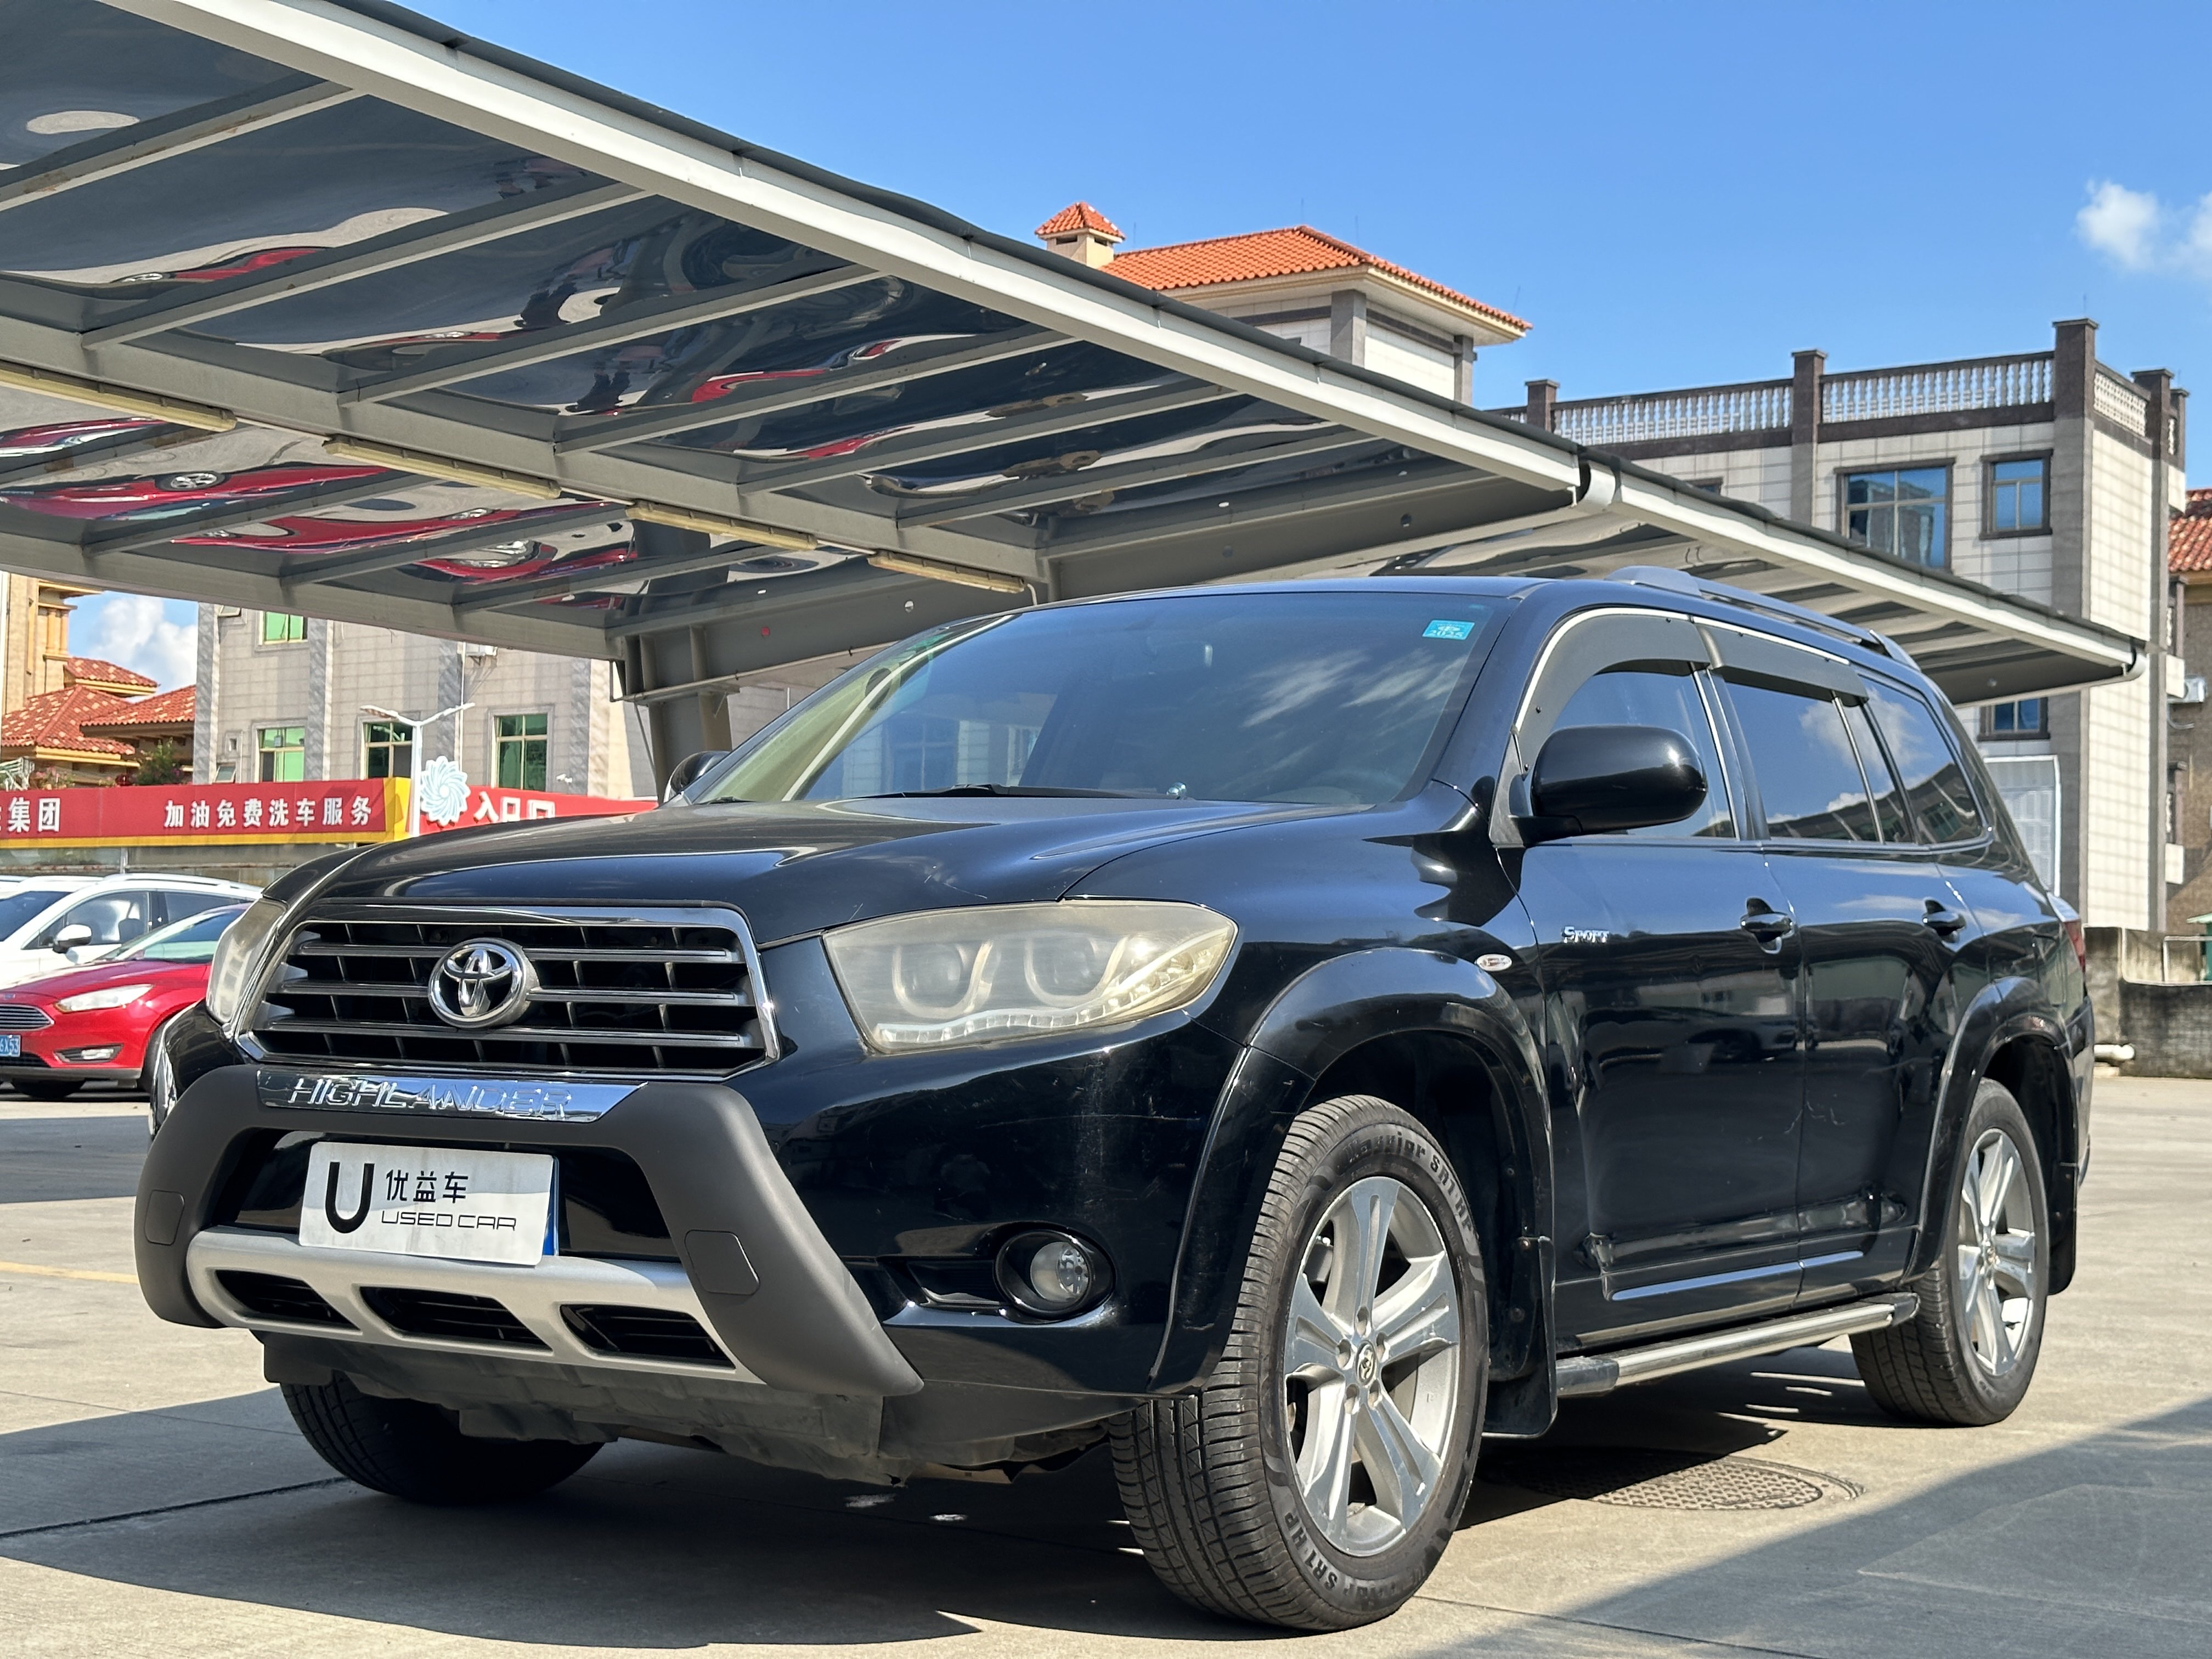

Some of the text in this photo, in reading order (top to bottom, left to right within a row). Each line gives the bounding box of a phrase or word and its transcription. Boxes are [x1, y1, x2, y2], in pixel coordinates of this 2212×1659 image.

[0, 797, 60, 832] 集团
[164, 795, 372, 828] 加油免费洗车服务
[287, 1077, 572, 1119] HIGHLANDER
[325, 1161, 375, 1234] U
[385, 1169, 469, 1204] 优益车
[381, 1211, 517, 1232] USED CAR
